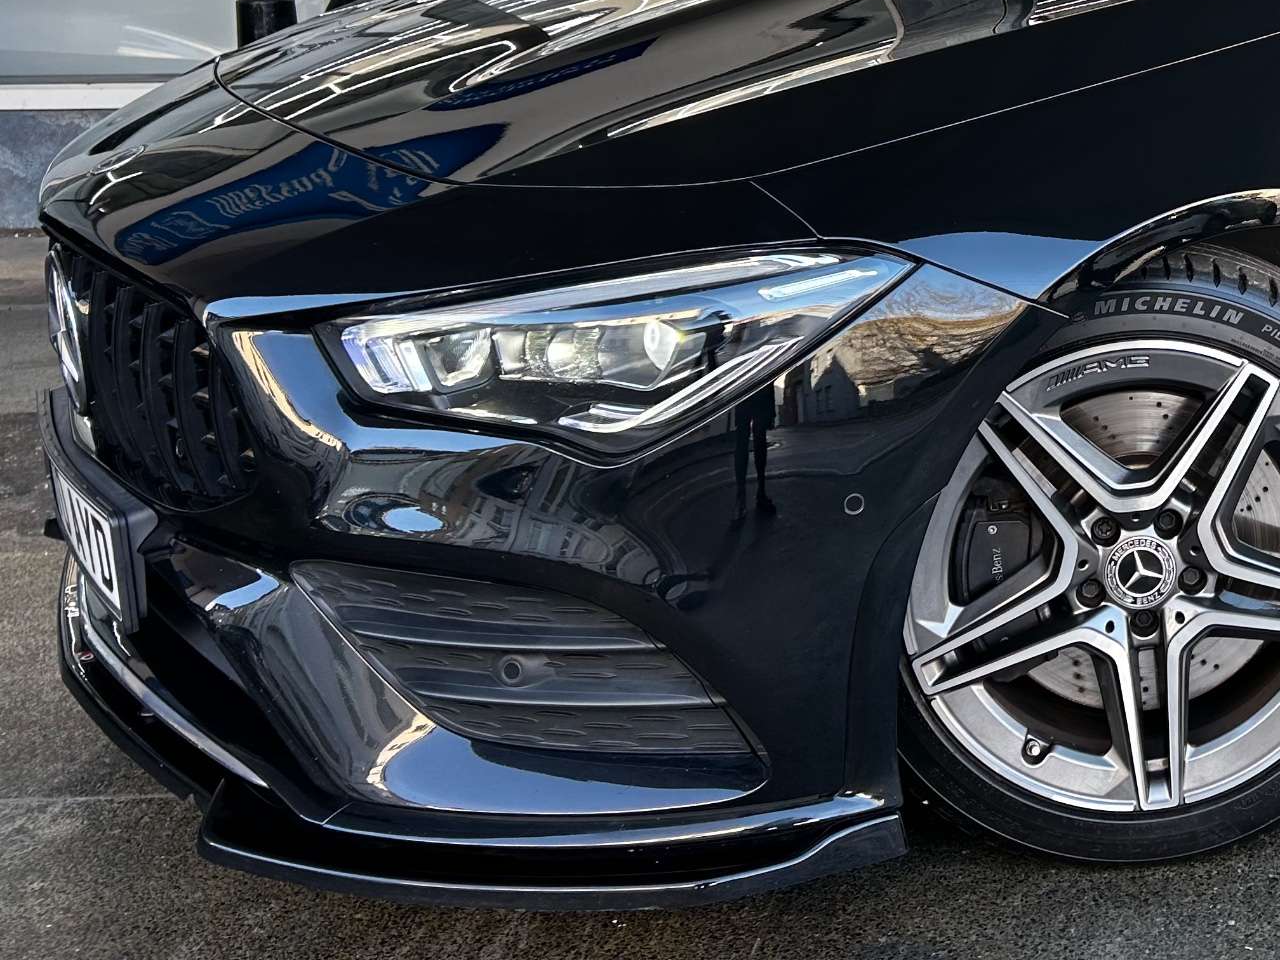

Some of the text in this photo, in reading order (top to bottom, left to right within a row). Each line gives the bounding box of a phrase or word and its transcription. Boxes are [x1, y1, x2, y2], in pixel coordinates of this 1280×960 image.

[1094, 296, 1245, 325] MICHELIN
[1112, 539, 1157, 561] MERCEDES
[1136, 591, 1160, 605] BENZ
